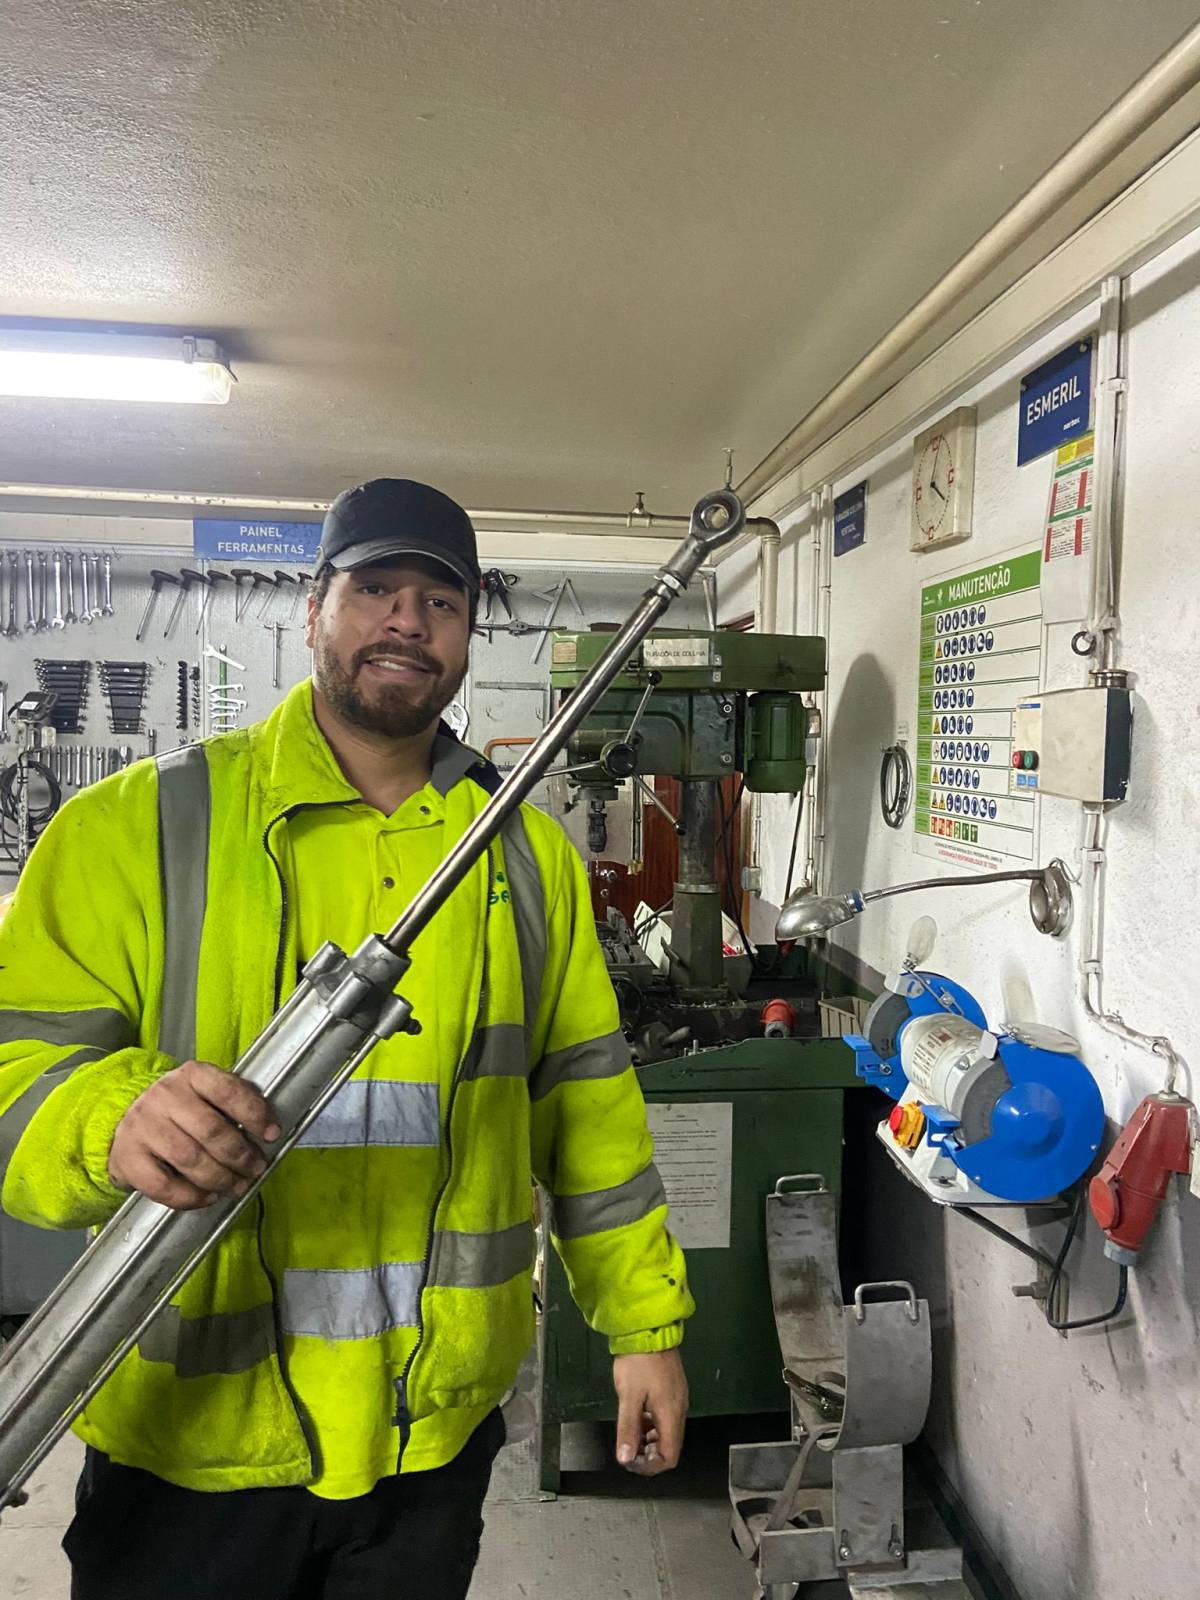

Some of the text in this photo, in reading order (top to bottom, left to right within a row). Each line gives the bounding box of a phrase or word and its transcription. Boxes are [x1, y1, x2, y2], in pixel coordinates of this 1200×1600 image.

[1026, 375, 1081, 426] ESMERIL
[239, 526, 283, 538] PAINEL
[217, 541, 305, 555] FERRAMENTAS
[948, 565, 1011, 602] MANUTENÇÃO
